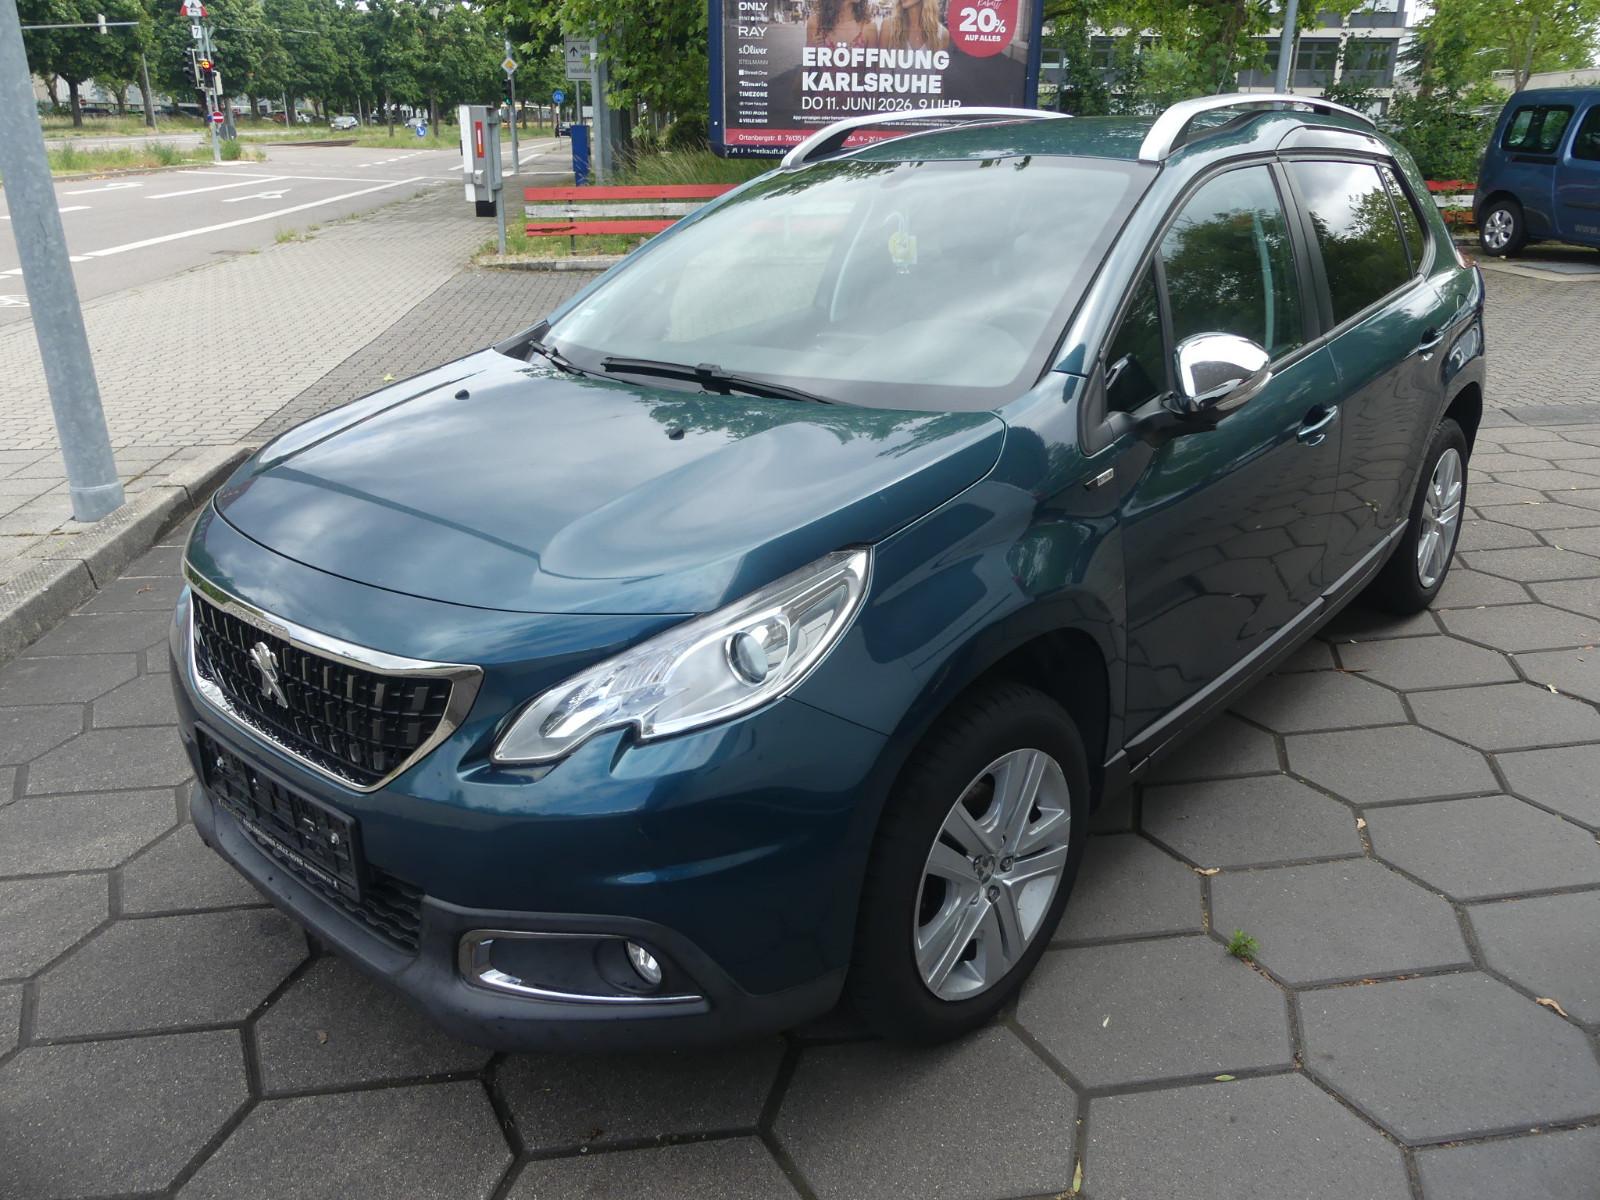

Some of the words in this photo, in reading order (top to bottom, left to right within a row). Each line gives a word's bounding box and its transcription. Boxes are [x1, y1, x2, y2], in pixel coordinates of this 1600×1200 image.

[738, 2, 768, 11] ONLY
[960, 7, 1006, 33] 20%
[738, 26, 768, 37] RAY
[738, 44, 768, 55] s.Oliver
[802, 42, 950, 70] ERÖFFNUNG
[802, 72, 942, 94] KARLSRUHE
[802, 97, 823, 110] DO
[825, 97, 839, 110] 11.
[842, 97, 876, 110] JUNI
[919, 99, 927, 109] 9
[931, 99, 961, 109] UHR
